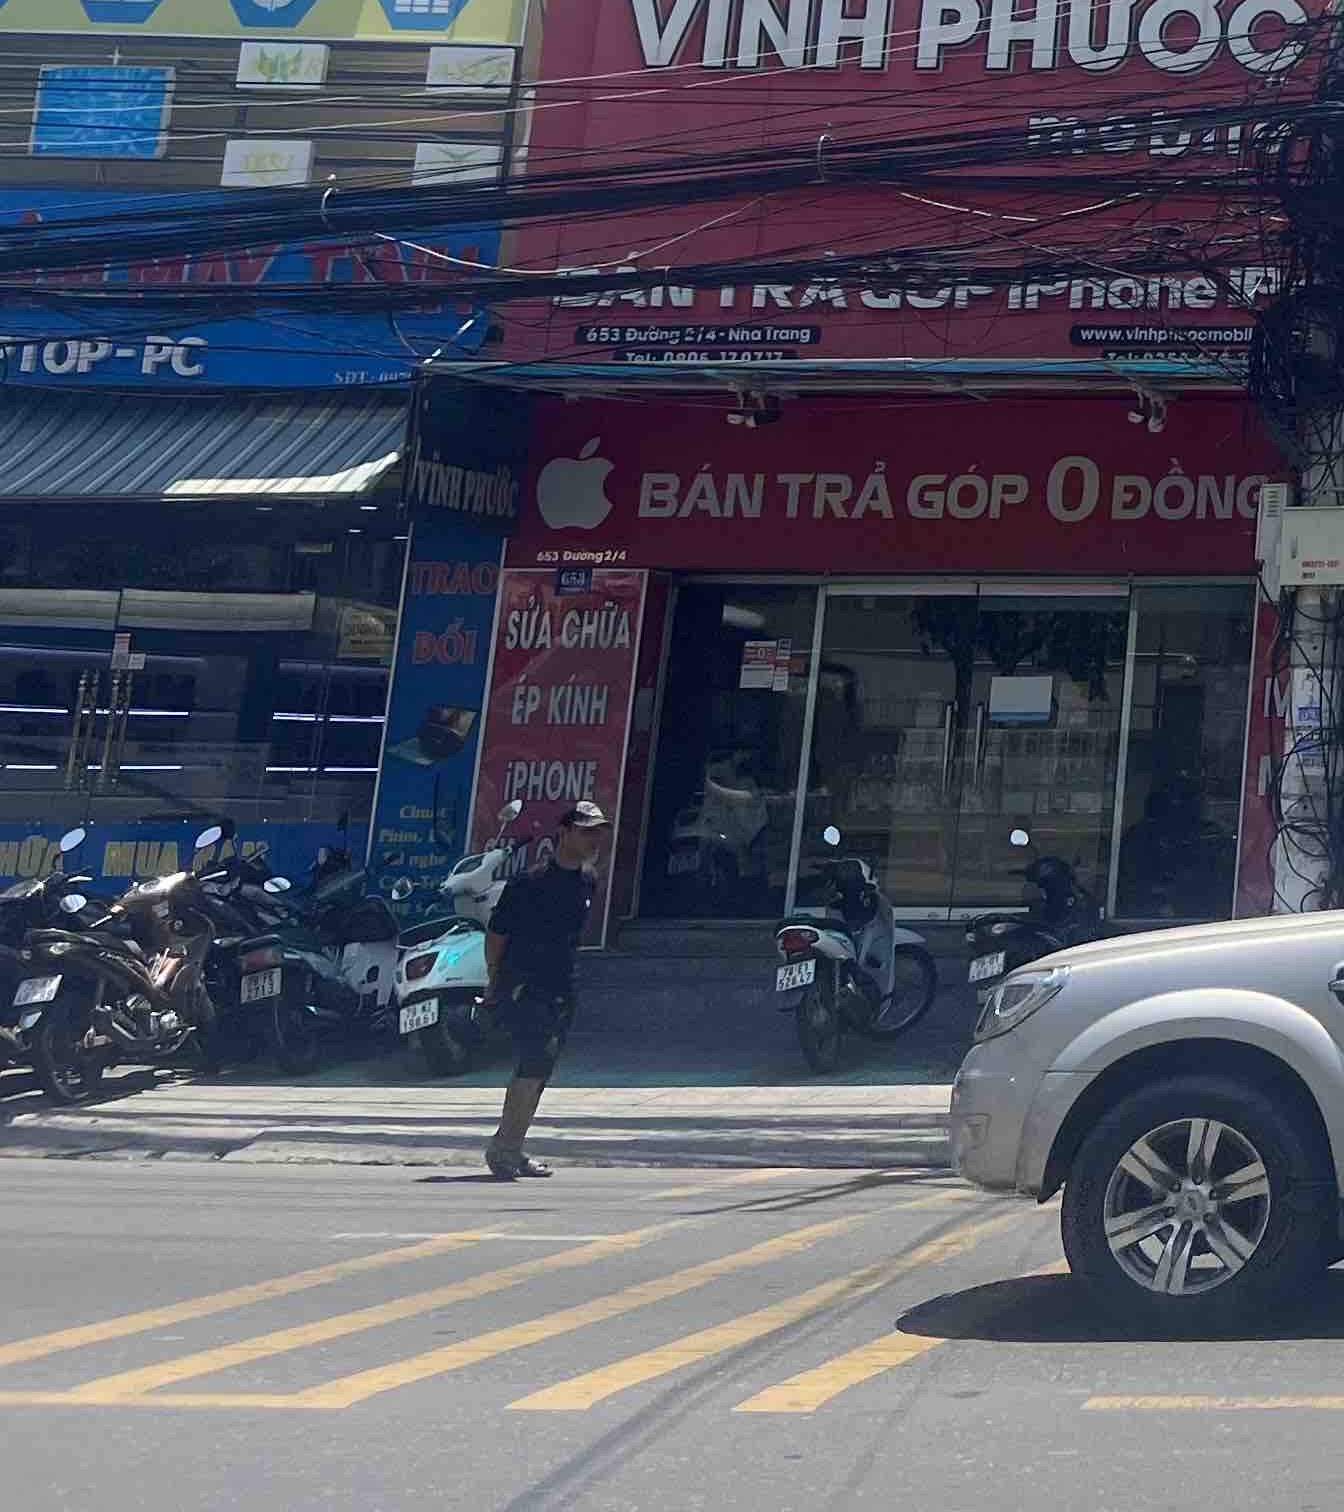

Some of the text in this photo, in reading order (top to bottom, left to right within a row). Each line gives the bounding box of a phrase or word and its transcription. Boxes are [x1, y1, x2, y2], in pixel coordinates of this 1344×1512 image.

[586, 328, 620, 343] 653
[728, 327, 762, 342] Nha
[765, 326, 811, 345] Trang
[638, 454, 1265, 523] BÁN TRẢ GÓP 0 ĐỒNG
[410, 561, 501, 595] TRAO
[505, 595, 632, 650] SỬA CHỮA
[511, 673, 609, 726] ÉP KÍNH
[504, 759, 599, 801] iPHONE
[102, 840, 180, 878] MUA
